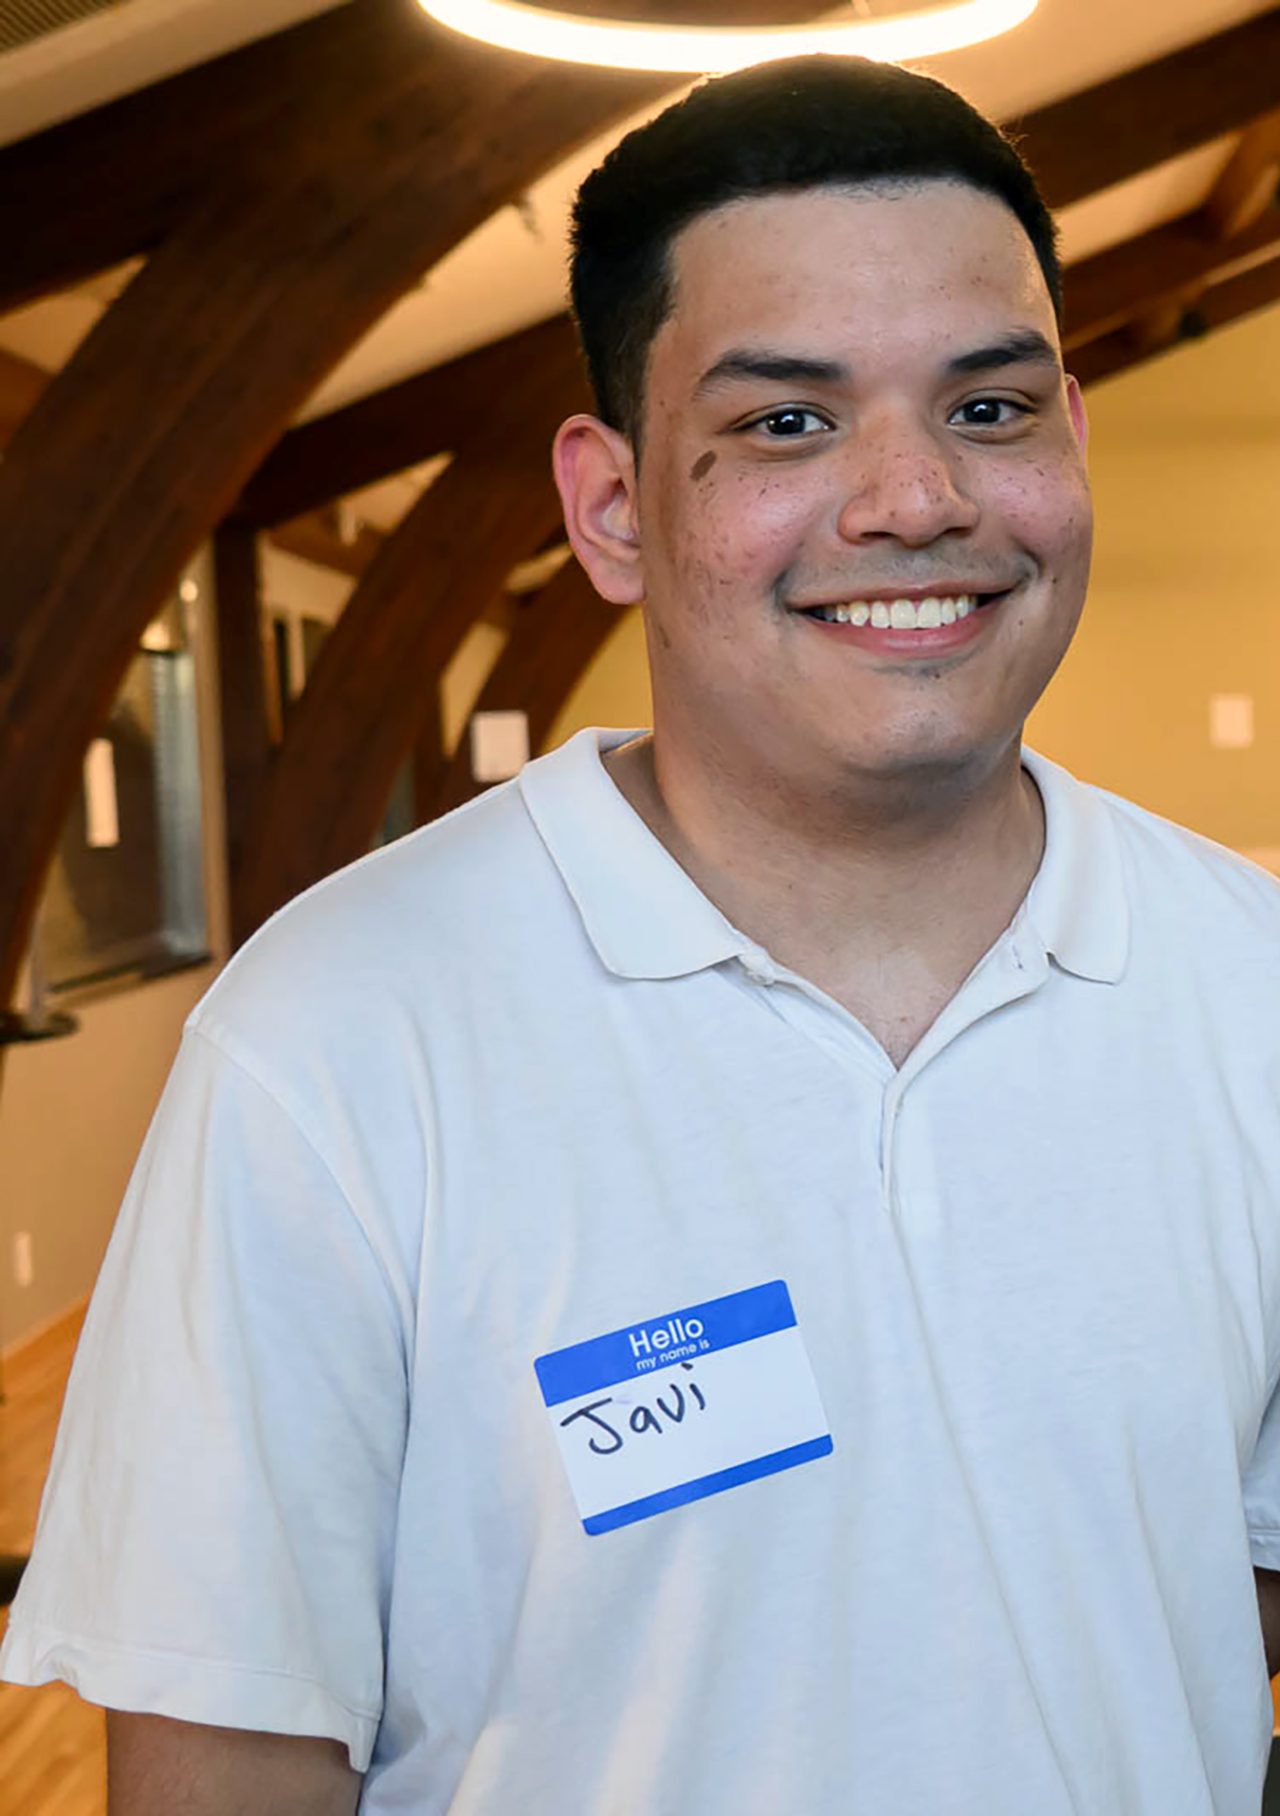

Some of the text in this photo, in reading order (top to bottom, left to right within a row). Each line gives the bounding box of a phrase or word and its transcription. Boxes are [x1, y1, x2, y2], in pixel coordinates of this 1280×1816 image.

[628, 1318, 704, 1358] Hello
[636, 1338, 711, 1371] my name is
[559, 1362, 706, 1455] Javi
